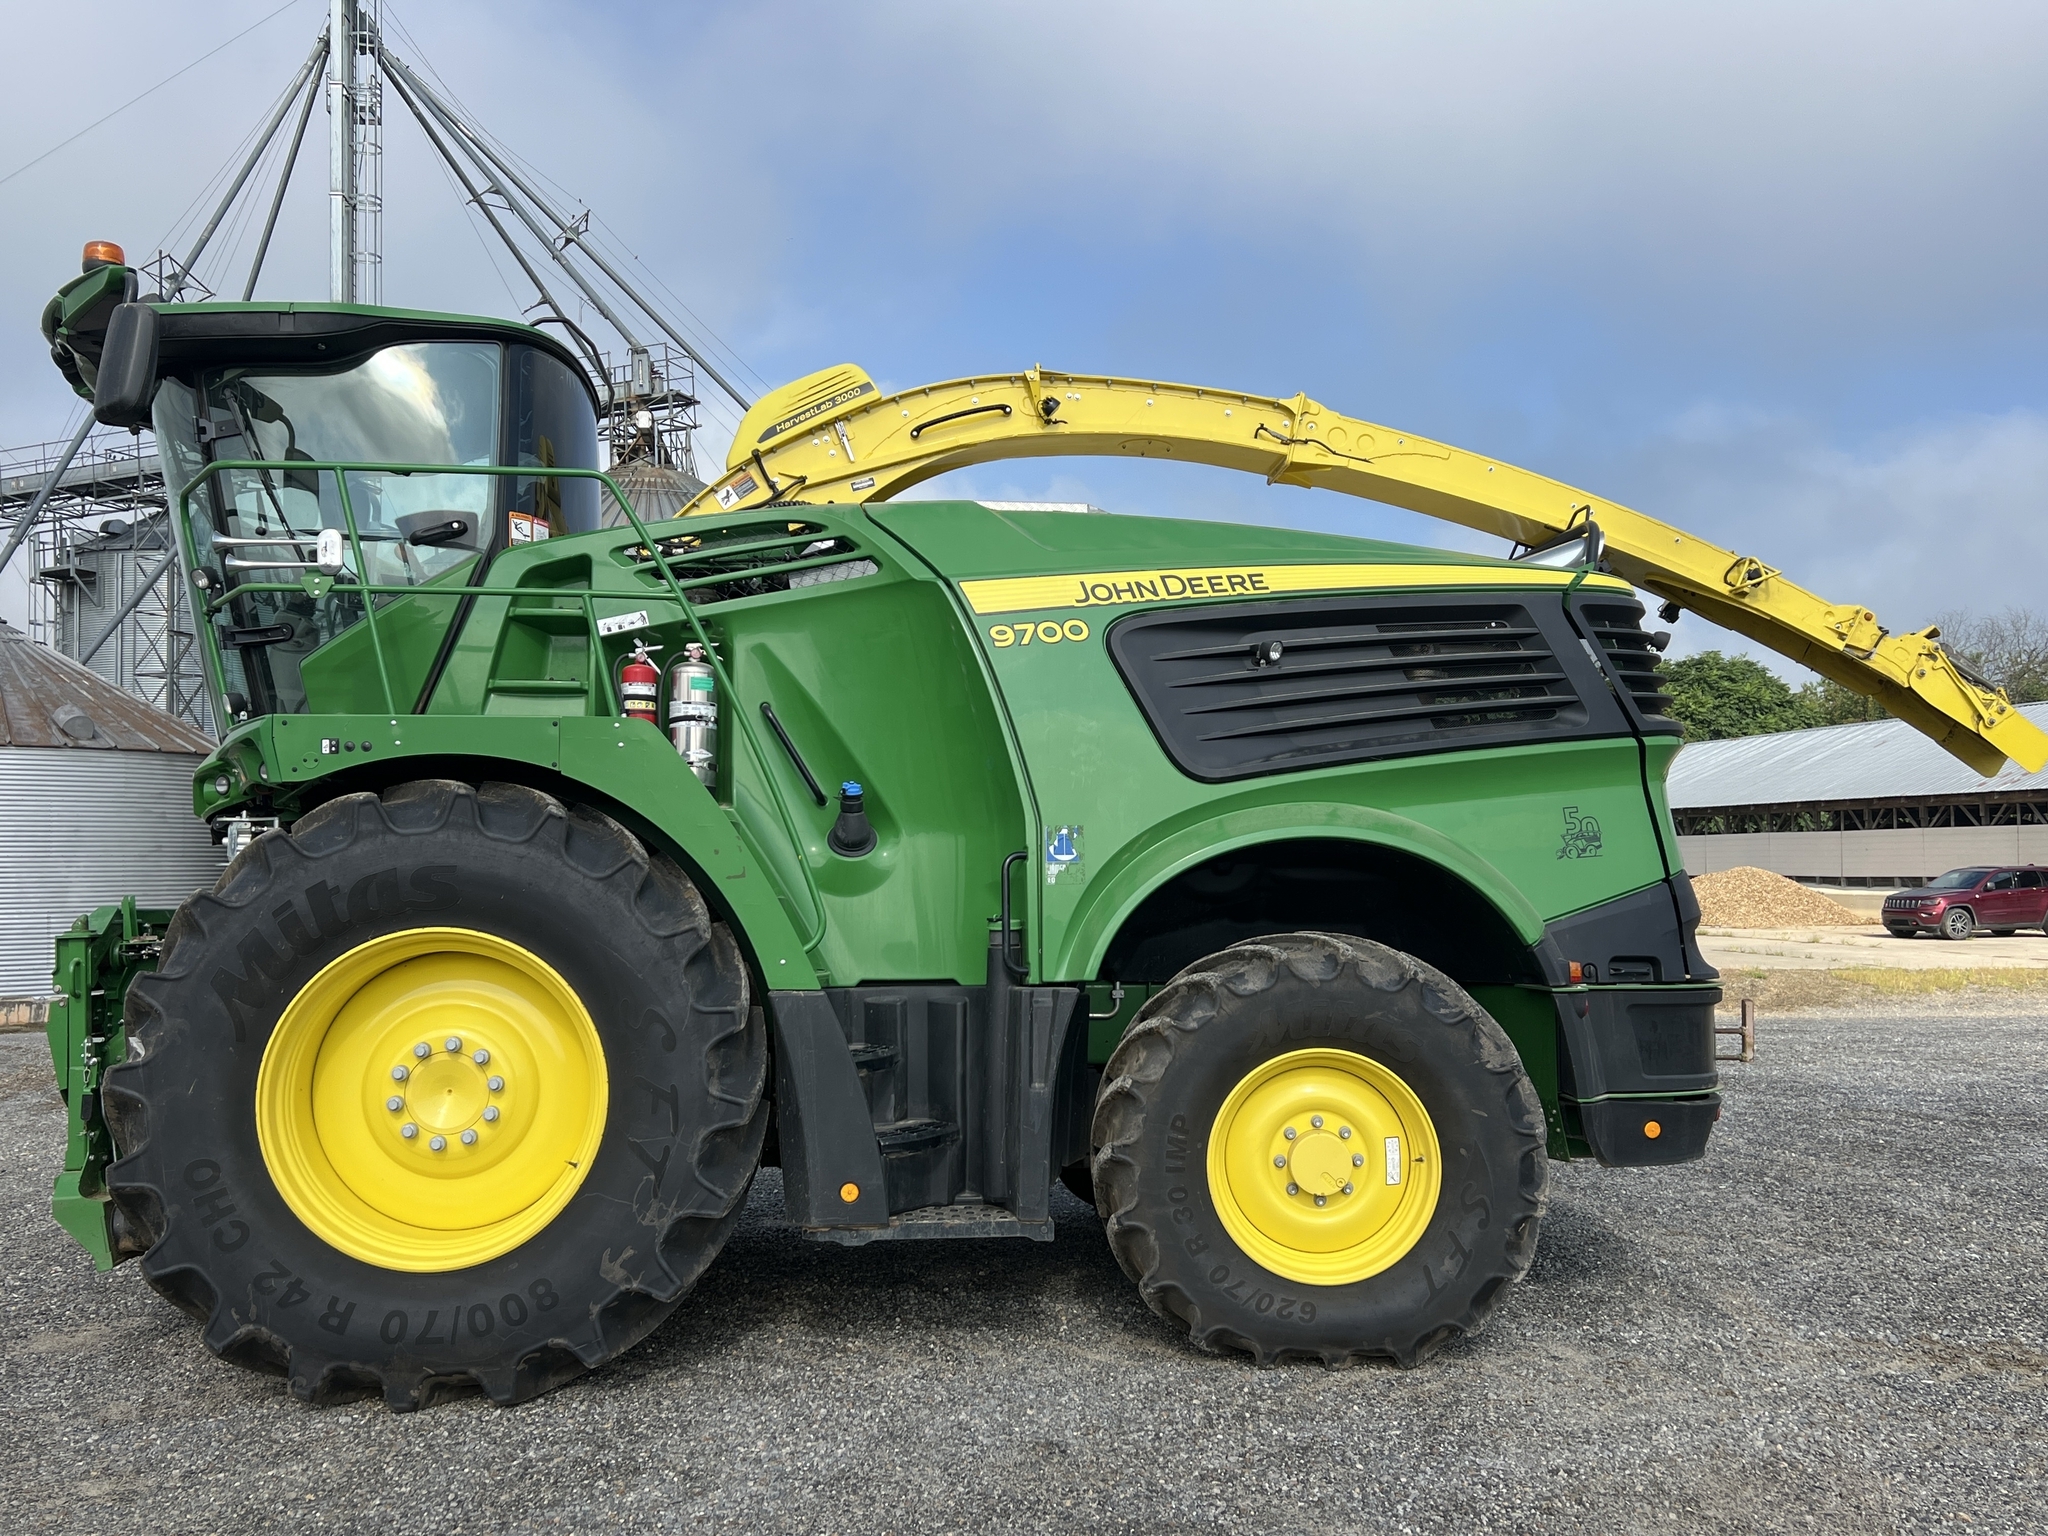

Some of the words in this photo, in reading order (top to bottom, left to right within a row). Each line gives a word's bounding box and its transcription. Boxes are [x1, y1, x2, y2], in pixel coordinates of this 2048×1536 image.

[775, 400, 833, 433] HarvestLab
[835, 388, 861, 404] 3000
[1075, 580, 1158, 604] JOHN
[1159, 573, 1270, 596] DEERE
[988, 618, 1090, 648] 9700
[210, 864, 461, 1043] Mitas
[1165, 1113, 1190, 1174] IMP
[183, 1158, 250, 1253] CHO
[1167, 1185, 1195, 1226] 30
[1184, 1232, 1210, 1259] R
[252, 1258, 312, 1309] 42
[1208, 1264, 1318, 1325] 620/70
[317, 1294, 358, 1336] R
[379, 1277, 560, 1346] 800/70
